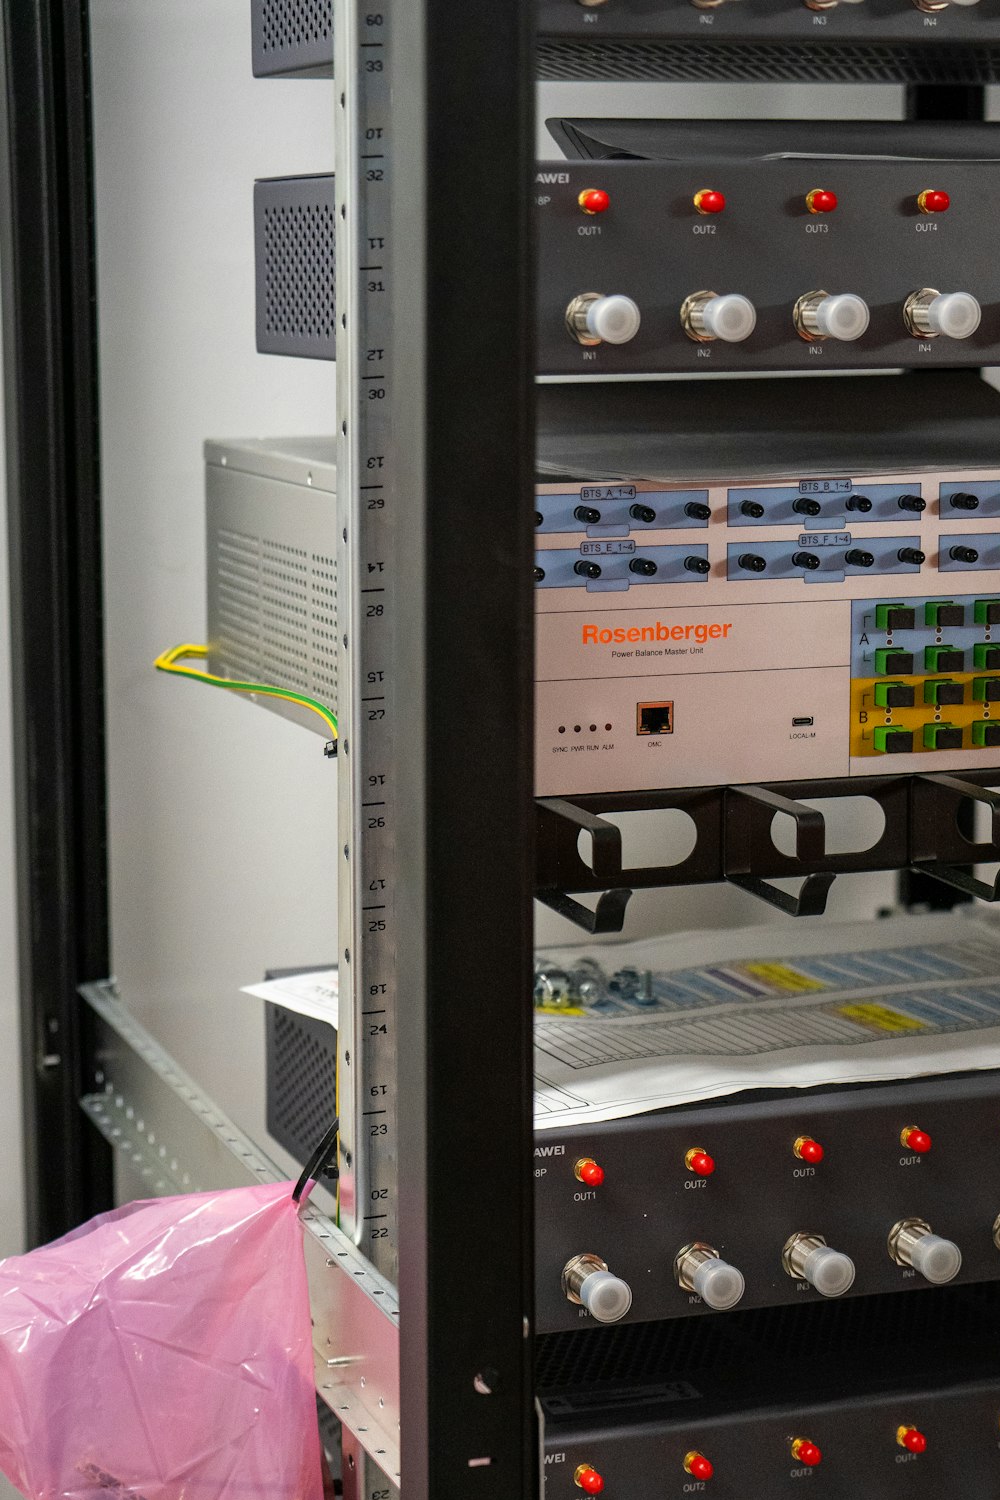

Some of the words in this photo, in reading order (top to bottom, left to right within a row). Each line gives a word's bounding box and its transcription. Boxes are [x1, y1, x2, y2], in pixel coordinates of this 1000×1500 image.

[699, 14, 714, 24] IN2
[812, 16, 827, 26] IN3
[923, 17, 937, 26] IN4
[365, 60, 383, 72] 33
[365, 128, 383, 139] 10
[366, 170, 384, 182] 32
[535, 196, 550, 206] 8P
[578, 226, 602, 236] OUT1
[693, 225, 716, 234] OUT2
[805, 224, 828, 233] OUT3
[916, 222, 938, 232] OUT4
[368, 238, 384, 250] 11
[368, 282, 385, 292] 31
[697, 348, 711, 358] IN2
[809, 346, 822, 355] IN3
[918, 344, 932, 353] IN4
[366, 350, 384, 360] 12
[583, 351, 598, 361] IN1
[368, 388, 385, 400] 30
[366, 456, 384, 468] 13
[368, 498, 385, 510] 29
[368, 562, 384, 573] 14
[366, 605, 384, 616] 28
[582, 622, 732, 645] Rosenberger
[859, 632, 870, 646] A
[612, 650, 634, 659] Power
[636, 648, 662, 658] Balance
[664, 648, 688, 656] Master
[690, 647, 704, 656] Unit
[368, 672, 384, 682] 15
[368, 710, 385, 720] 27
[860, 711, 868, 724] B
[789, 732, 816, 740] LOCAL-M
[586, 744, 600, 752] RUN
[368, 775, 386, 786] 16
[368, 817, 385, 828] 26
[369, 880, 386, 890] 17
[368, 920, 386, 932] 25
[370, 984, 386, 995] 18
[370, 1024, 388, 1036] 24
[370, 1084, 387, 1096] 19
[370, 1124, 388, 1136] 23
[534, 1145, 566, 1158] AWEI
[900, 1157, 921, 1166] OUT4
[534, 1168, 547, 1178] 8P
[792, 1168, 816, 1178] OUT3
[684, 1180, 706, 1190] OUT2
[371, 1188, 388, 1200] 20
[574, 1192, 596, 1202] OUT1
[371, 1228, 388, 1239] 22
[902, 1270, 916, 1279] IN4
[797, 1282, 810, 1292] IN3
[688, 1296, 702, 1304] IN2
[790, 1468, 812, 1478] OUT3
[683, 1482, 705, 1492] OUT2
[372, 1490, 390, 1500] 23
